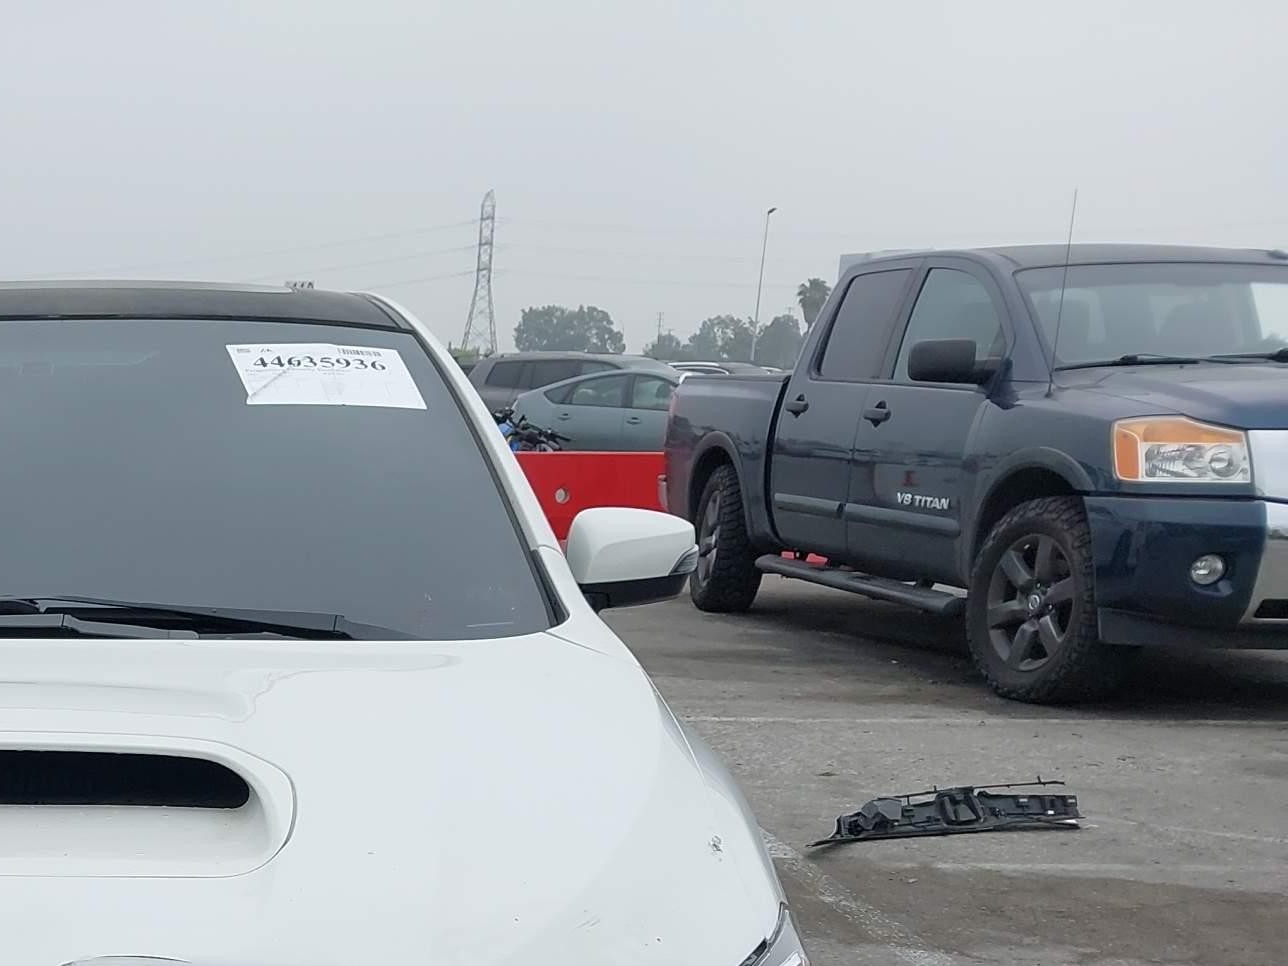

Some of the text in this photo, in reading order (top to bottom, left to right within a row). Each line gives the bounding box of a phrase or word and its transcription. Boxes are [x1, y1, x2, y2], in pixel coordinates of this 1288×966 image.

[253, 355, 387, 371] 44635936
[896, 492, 950, 510] V8 TITAN
